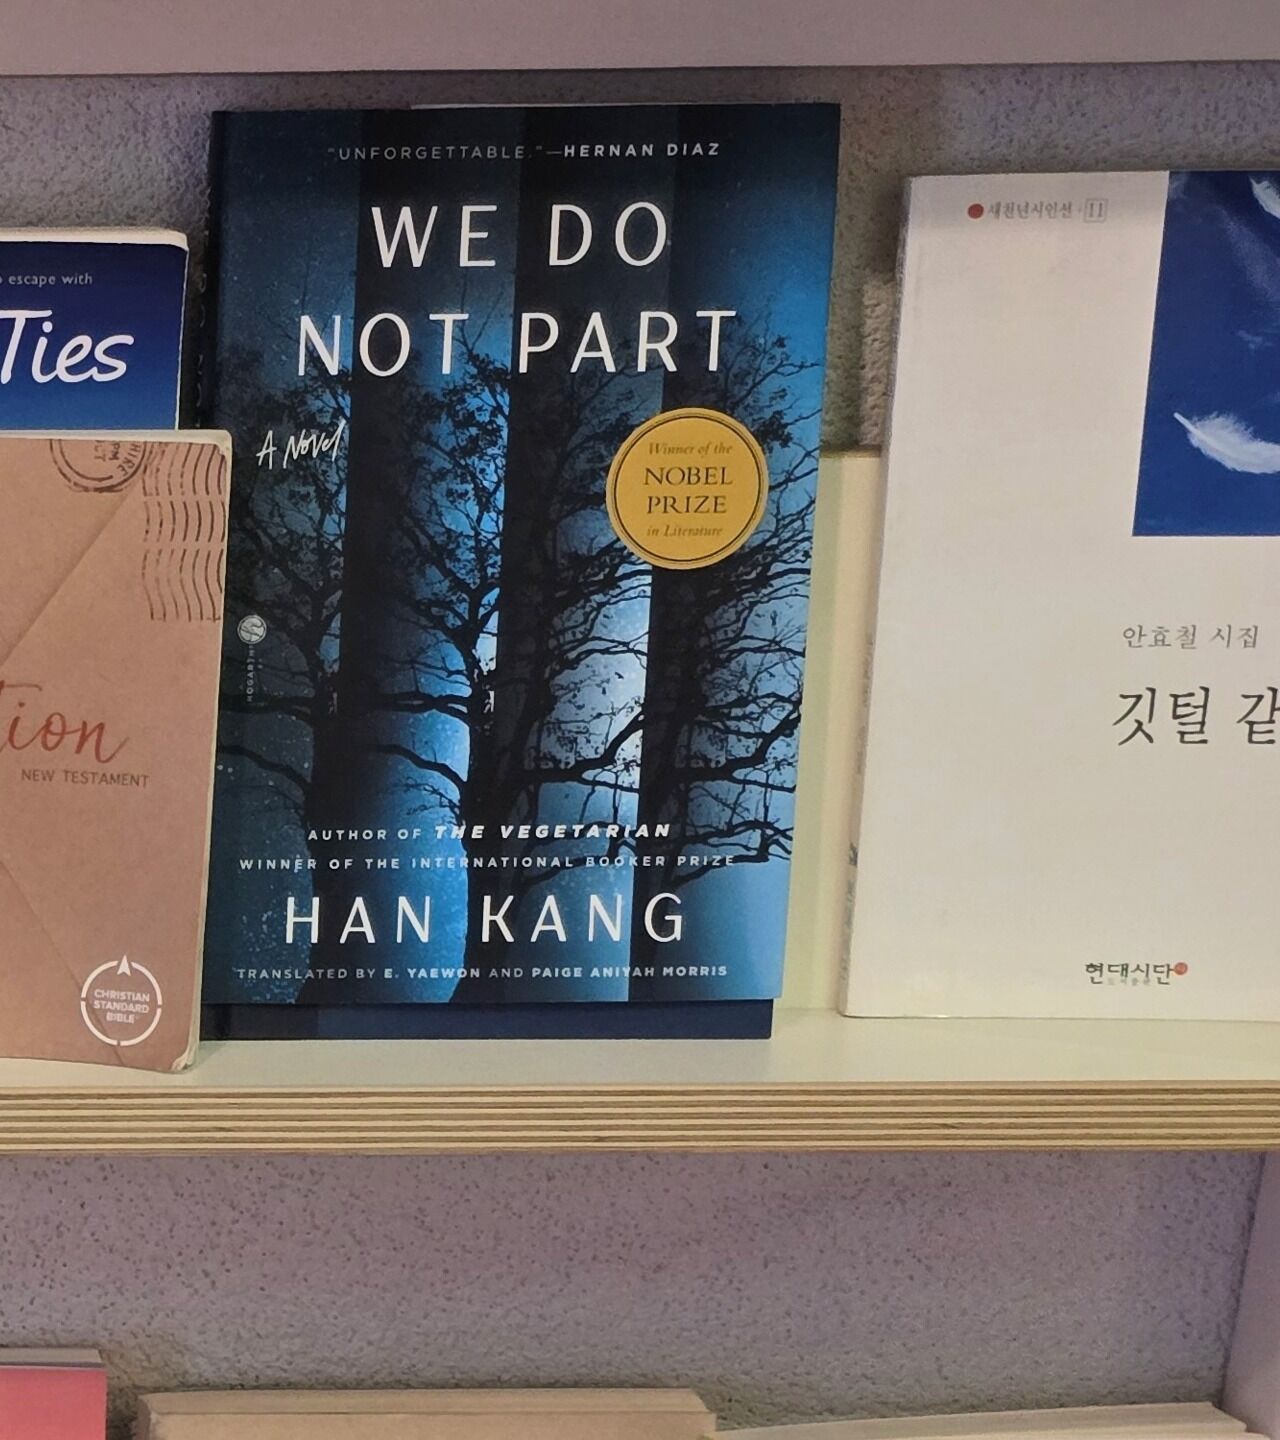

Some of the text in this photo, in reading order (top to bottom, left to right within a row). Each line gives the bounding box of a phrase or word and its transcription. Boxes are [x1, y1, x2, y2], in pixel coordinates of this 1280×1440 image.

[666, 142, 721, 157] DIAZ
[371, 200, 669, 269] WE DO
[8, 274, 62, 289] escape
[63, 271, 93, 286] with
[297, 309, 738, 378] NOT PART
[255, 419, 347, 470] A Novel
[647, 441, 734, 457] Winner of the
[642, 464, 734, 487] NOBEL
[646, 494, 728, 515] PRIZE
[646, 523, 724, 539] in Literature
[1122, 623, 1260, 651] 안효철 시집
[1111, 685, 1211, 746] 깃털
[20, 767, 150, 789] NEW TESTAMENT
[307, 822, 672, 843] AUTHOR OF THE VEGETARIAN
[238, 853, 737, 872] WINNER OF THE INTERNATIONAL BOOKER PRIZE
[284, 891, 685, 945] HAN KANG
[235, 963, 729, 981] TRANSLATED BY E. YAEWON AND PAIGE ANIYAH MORRIS
[1084, 961, 1174, 986] 현대시단
[93, 987, 152, 1003] CHRISTIAN
[92, 1000, 151, 1014] STANDARD
[104, 1011, 137, 1025] BIBLE
